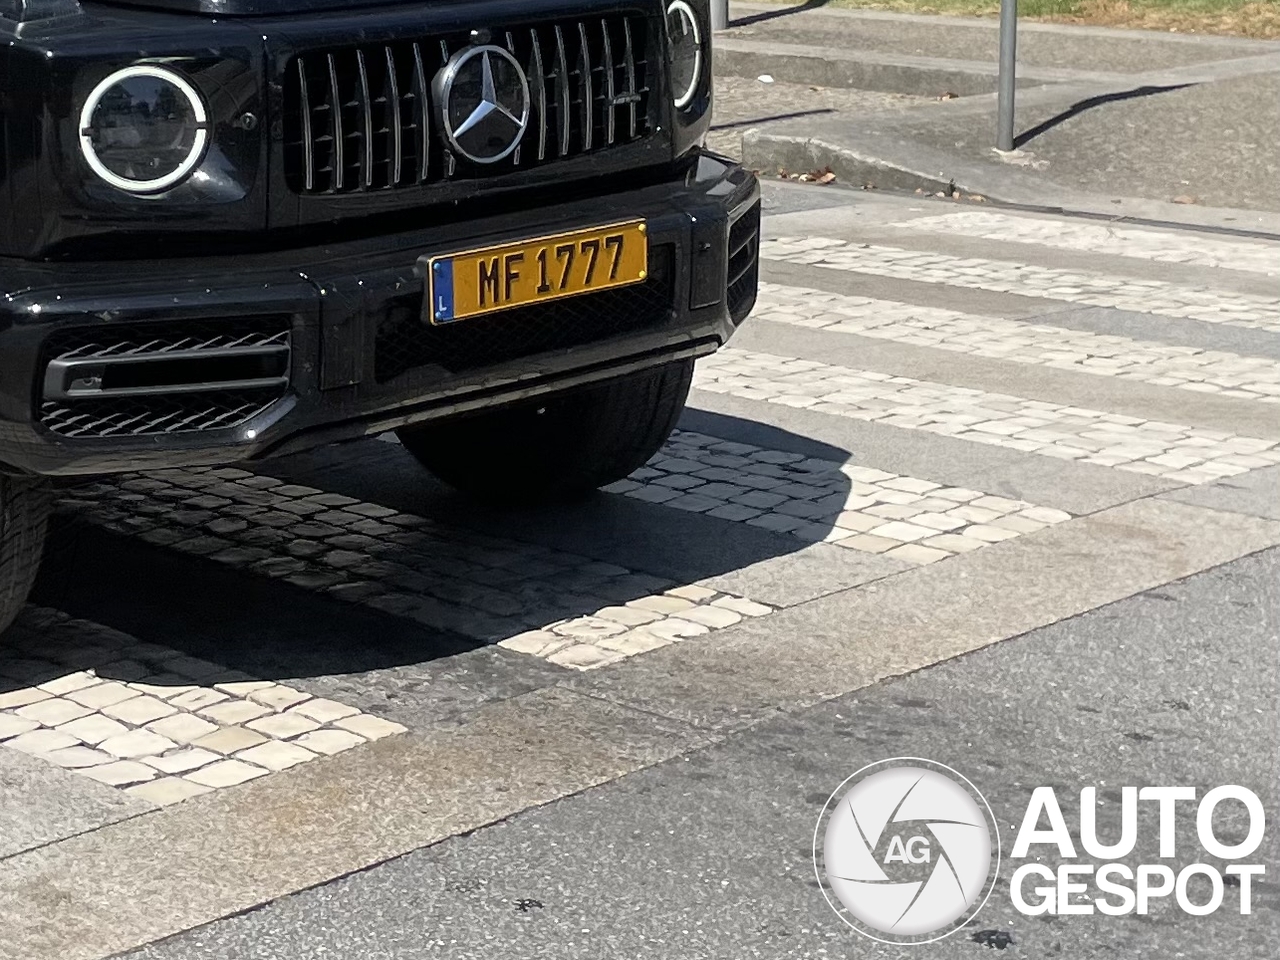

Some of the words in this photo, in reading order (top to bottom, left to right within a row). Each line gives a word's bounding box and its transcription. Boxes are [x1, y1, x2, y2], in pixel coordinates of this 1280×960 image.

[477, 250, 524, 307] MF
[535, 233, 624, 294] 1777
[438, 296, 448, 312] L
